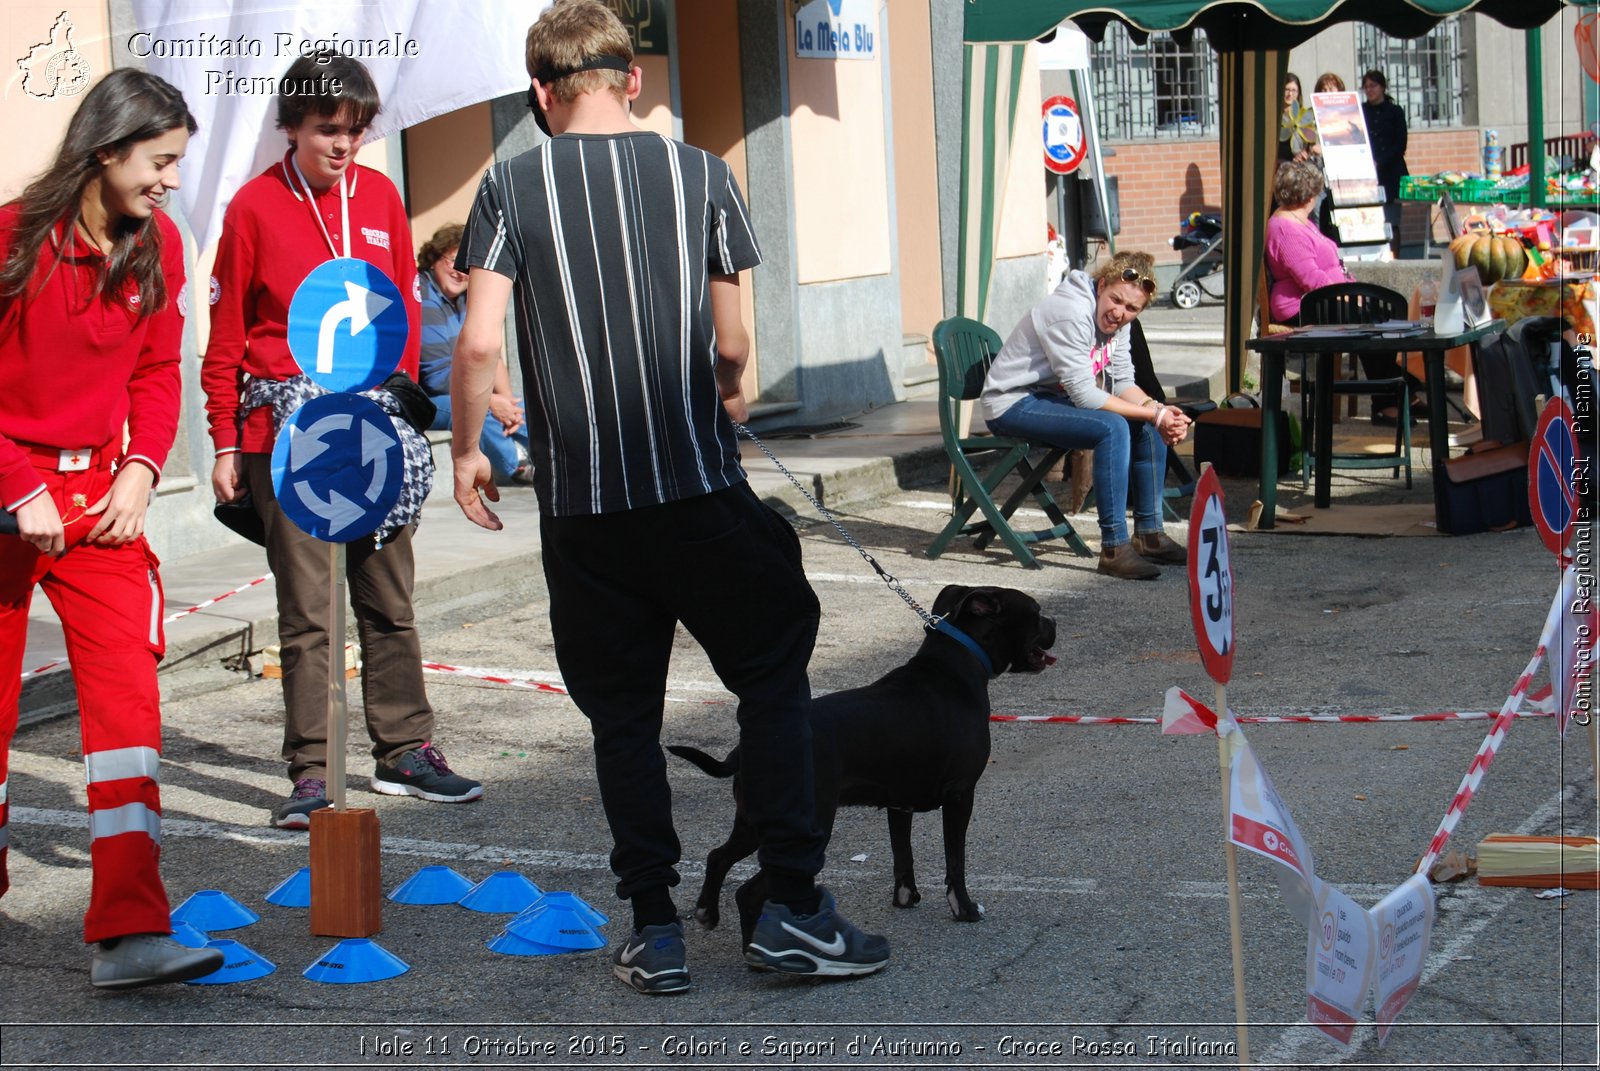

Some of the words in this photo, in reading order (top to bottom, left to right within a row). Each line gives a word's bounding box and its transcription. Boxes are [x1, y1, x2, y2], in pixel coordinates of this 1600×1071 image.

[797, 20, 813, 51] La
[817, 22, 850, 52] Mela
[854, 24, 873, 53] Blu
[1339, 910, 1347, 921] se
[1397, 899, 1413, 919] quando
[1323, 923, 1332, 941] 10
[1337, 929, 1352, 944] guido
[1395, 920, 1409, 938] guido
[1382, 933, 1390, 950] 10
